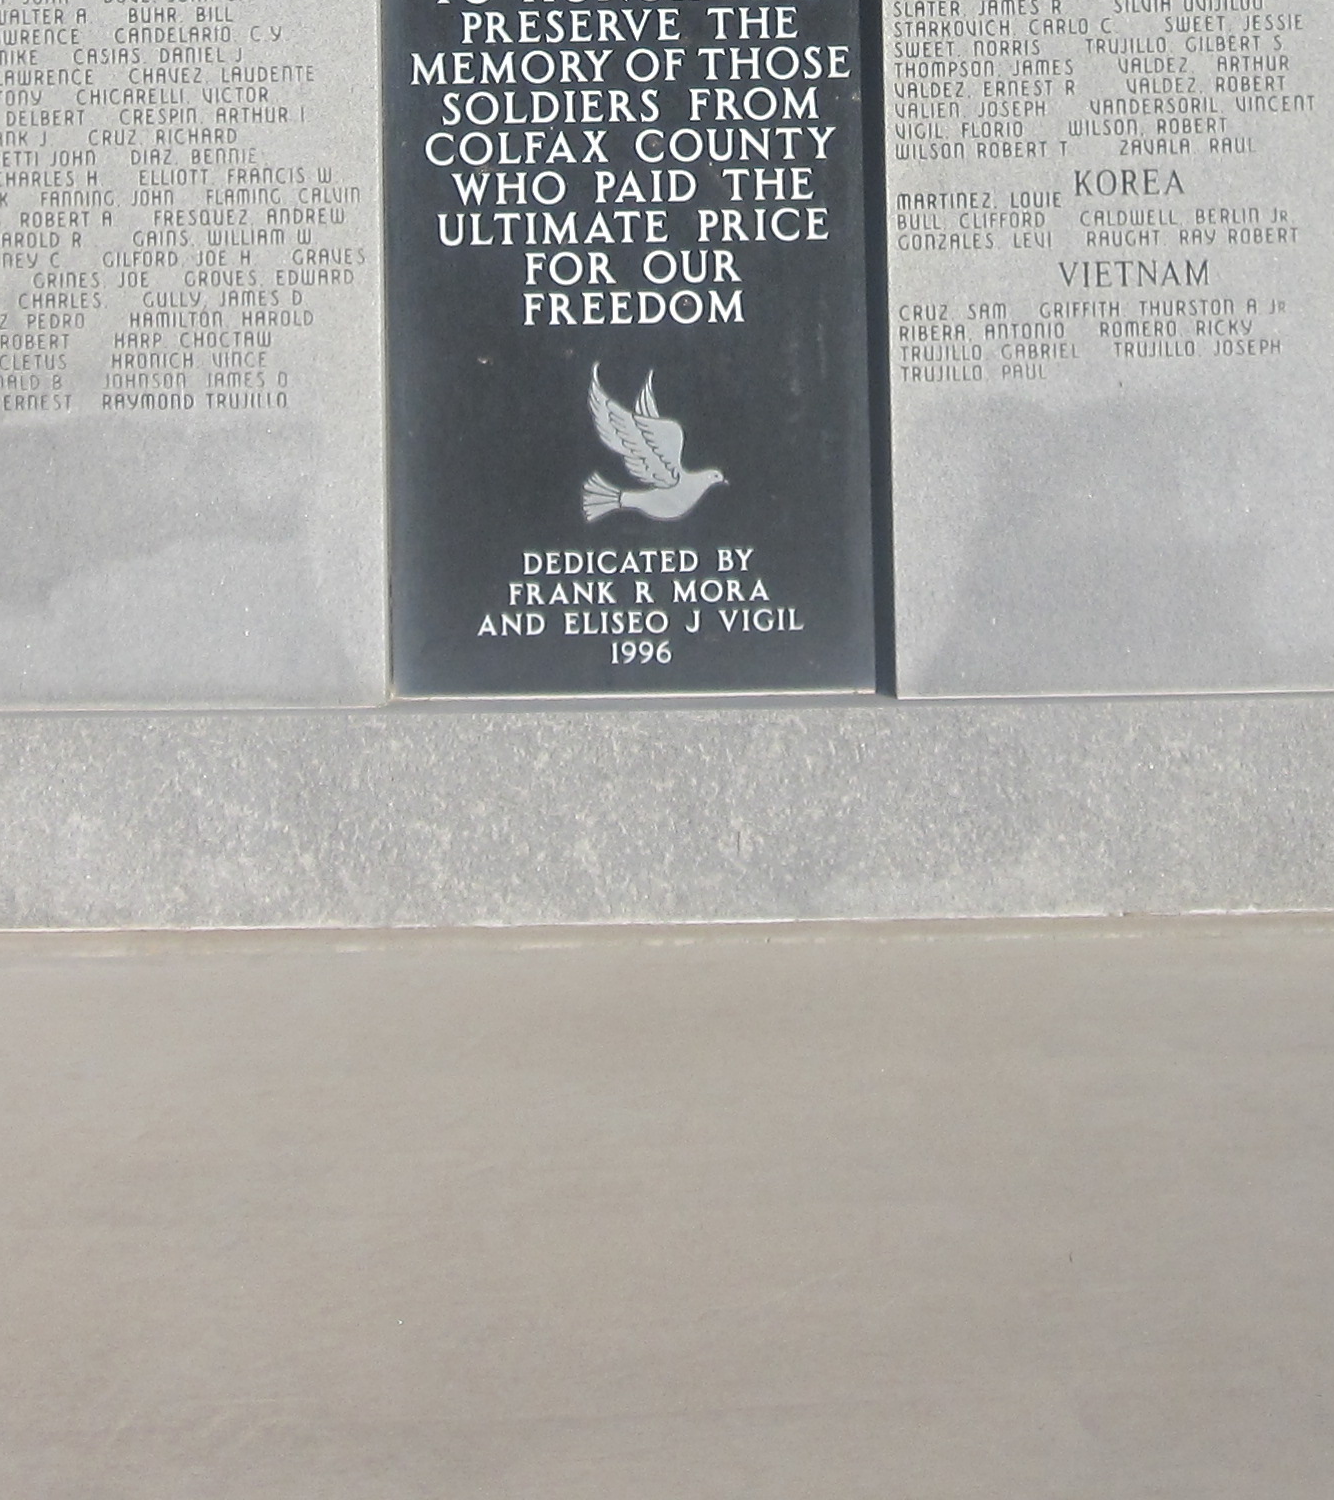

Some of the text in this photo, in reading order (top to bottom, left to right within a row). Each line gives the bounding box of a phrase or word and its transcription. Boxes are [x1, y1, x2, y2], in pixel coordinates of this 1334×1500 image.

[461, 6, 798, 44] PRESERVE THE
[410, 45, 851, 85] MEMORY OF THOSE
[1012, 58, 1074, 77] JAMES
[1216, 54, 1289, 73] ARTHUR
[201, 85, 269, 105] VICTOR
[983, 79, 1053, 98] ERNEST
[1215, 74, 1285, 93] ROBERT
[442, 86, 819, 126] SOLDIERS FROM
[977, 99, 1046, 119] JOSEPH
[1235, 94, 1314, 113] VINCENT
[155, 126, 238, 146] RICHARD
[961, 120, 1024, 139] FLORIO
[1156, 116, 1227, 135] ROBERT
[425, 126, 836, 166] COLFAX COUNTY
[227, 166, 306, 186] FRANCIS
[451, 167, 814, 206] WHO PAID THE
[1074, 168, 1185, 197] KOREA
[1010, 190, 1061, 209] LOUIE
[437, 207, 829, 247] ULTIMATE PRICE
[525, 249, 742, 286] FOR OUR
[1058, 258, 1209, 289] VIETNAM
[523, 289, 745, 326] FREEDOM
[984, 320, 1065, 340] ANTONIO
[1195, 318, 1252, 337] RICKY
[3, 393, 72, 412] ERNEST
[101, 391, 195, 410] RAYMOND
[205, 391, 288, 410] TRUJILLO
[523, 547, 754, 575] DEDICATED BY
[509, 578, 770, 606] FRANK R MORA
[477, 607, 804, 636] AND ELISEO J VIGIL
[611, 639, 672, 664] 1996
